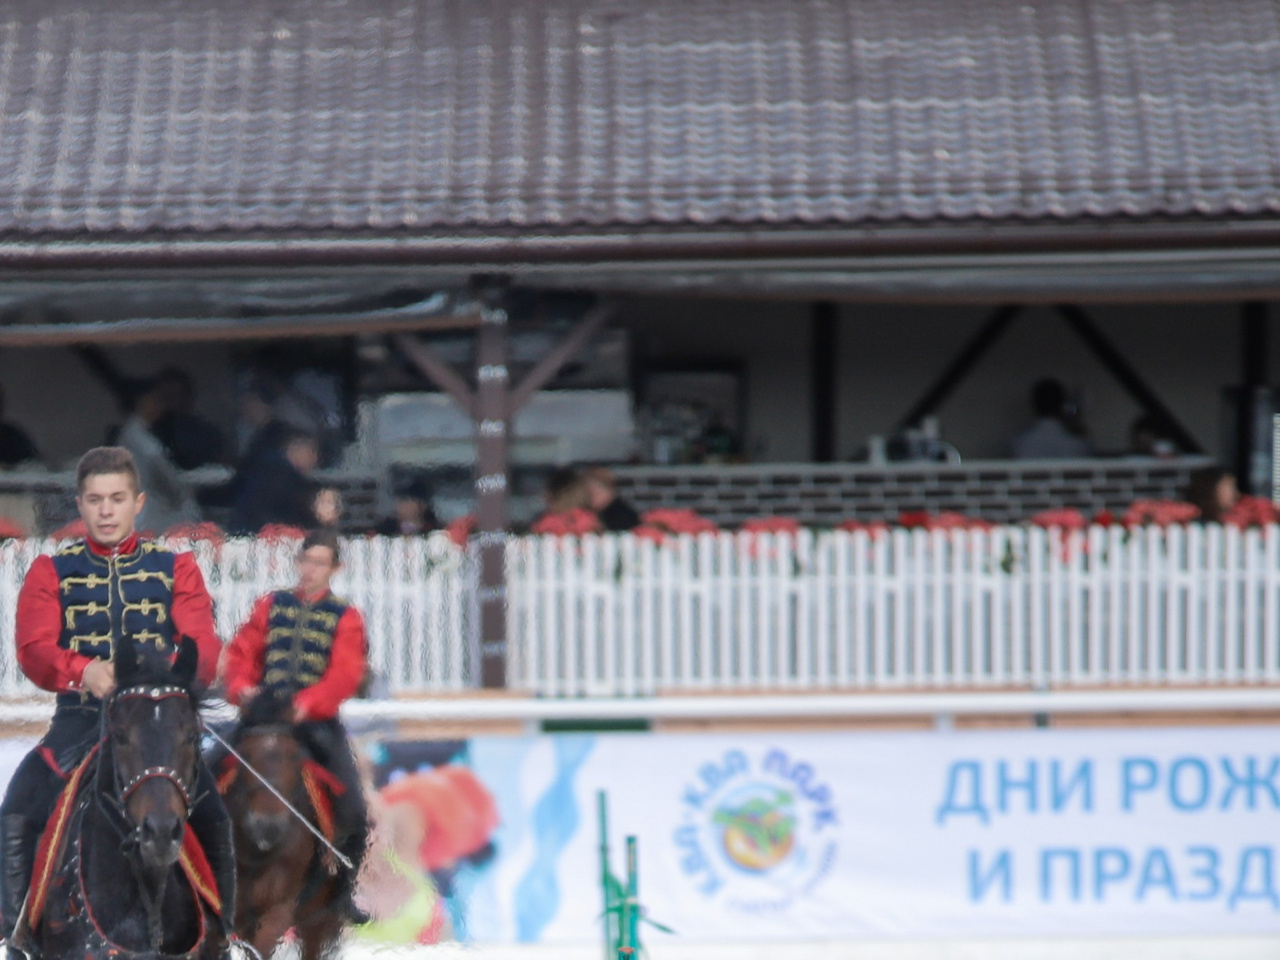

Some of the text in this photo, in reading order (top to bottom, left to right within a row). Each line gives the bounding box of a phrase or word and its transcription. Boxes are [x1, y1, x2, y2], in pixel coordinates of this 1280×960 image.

[933, 755, 1280, 826] ДНИ РОЖ
[967, 846, 1280, 913] И ПРАЗД
